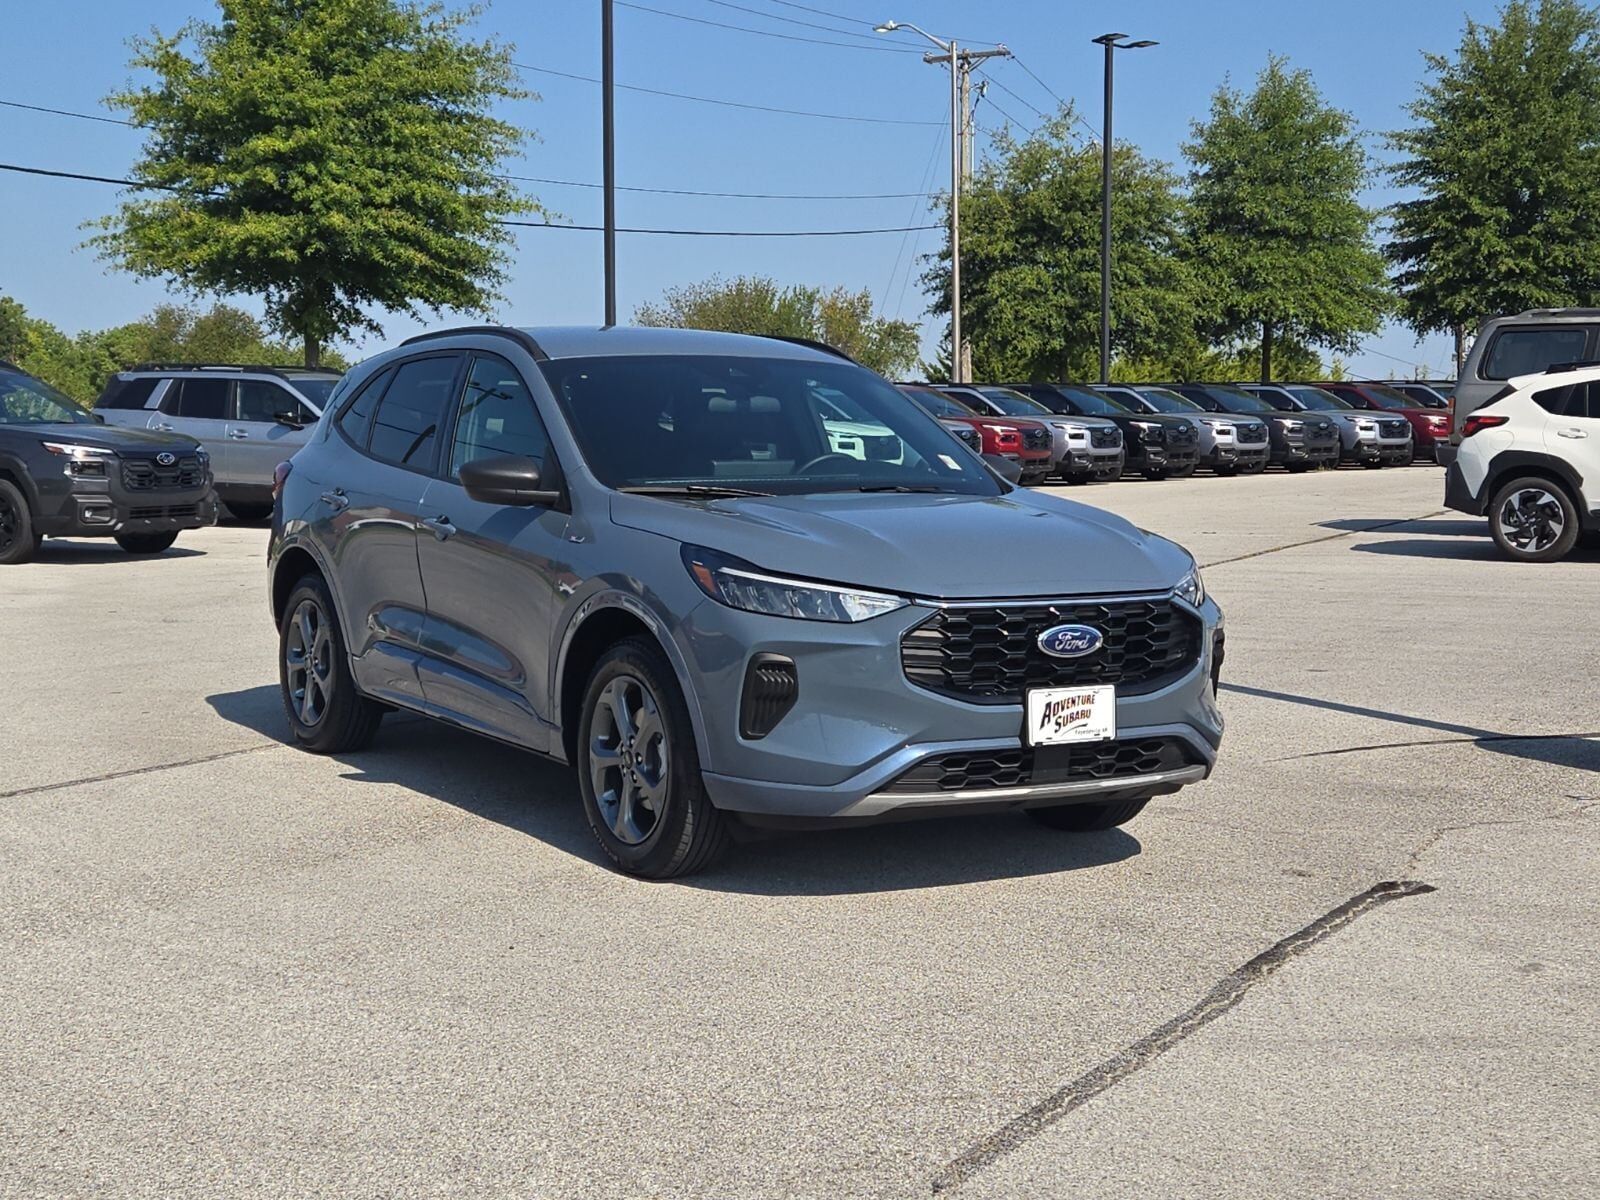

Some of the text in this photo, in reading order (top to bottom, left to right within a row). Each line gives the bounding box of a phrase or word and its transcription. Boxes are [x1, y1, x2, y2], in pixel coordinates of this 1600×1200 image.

[1055, 631, 1090, 650] Ford
[1039, 694, 1096, 730] ADVENTURE
[1054, 709, 1092, 733] SUBARU
